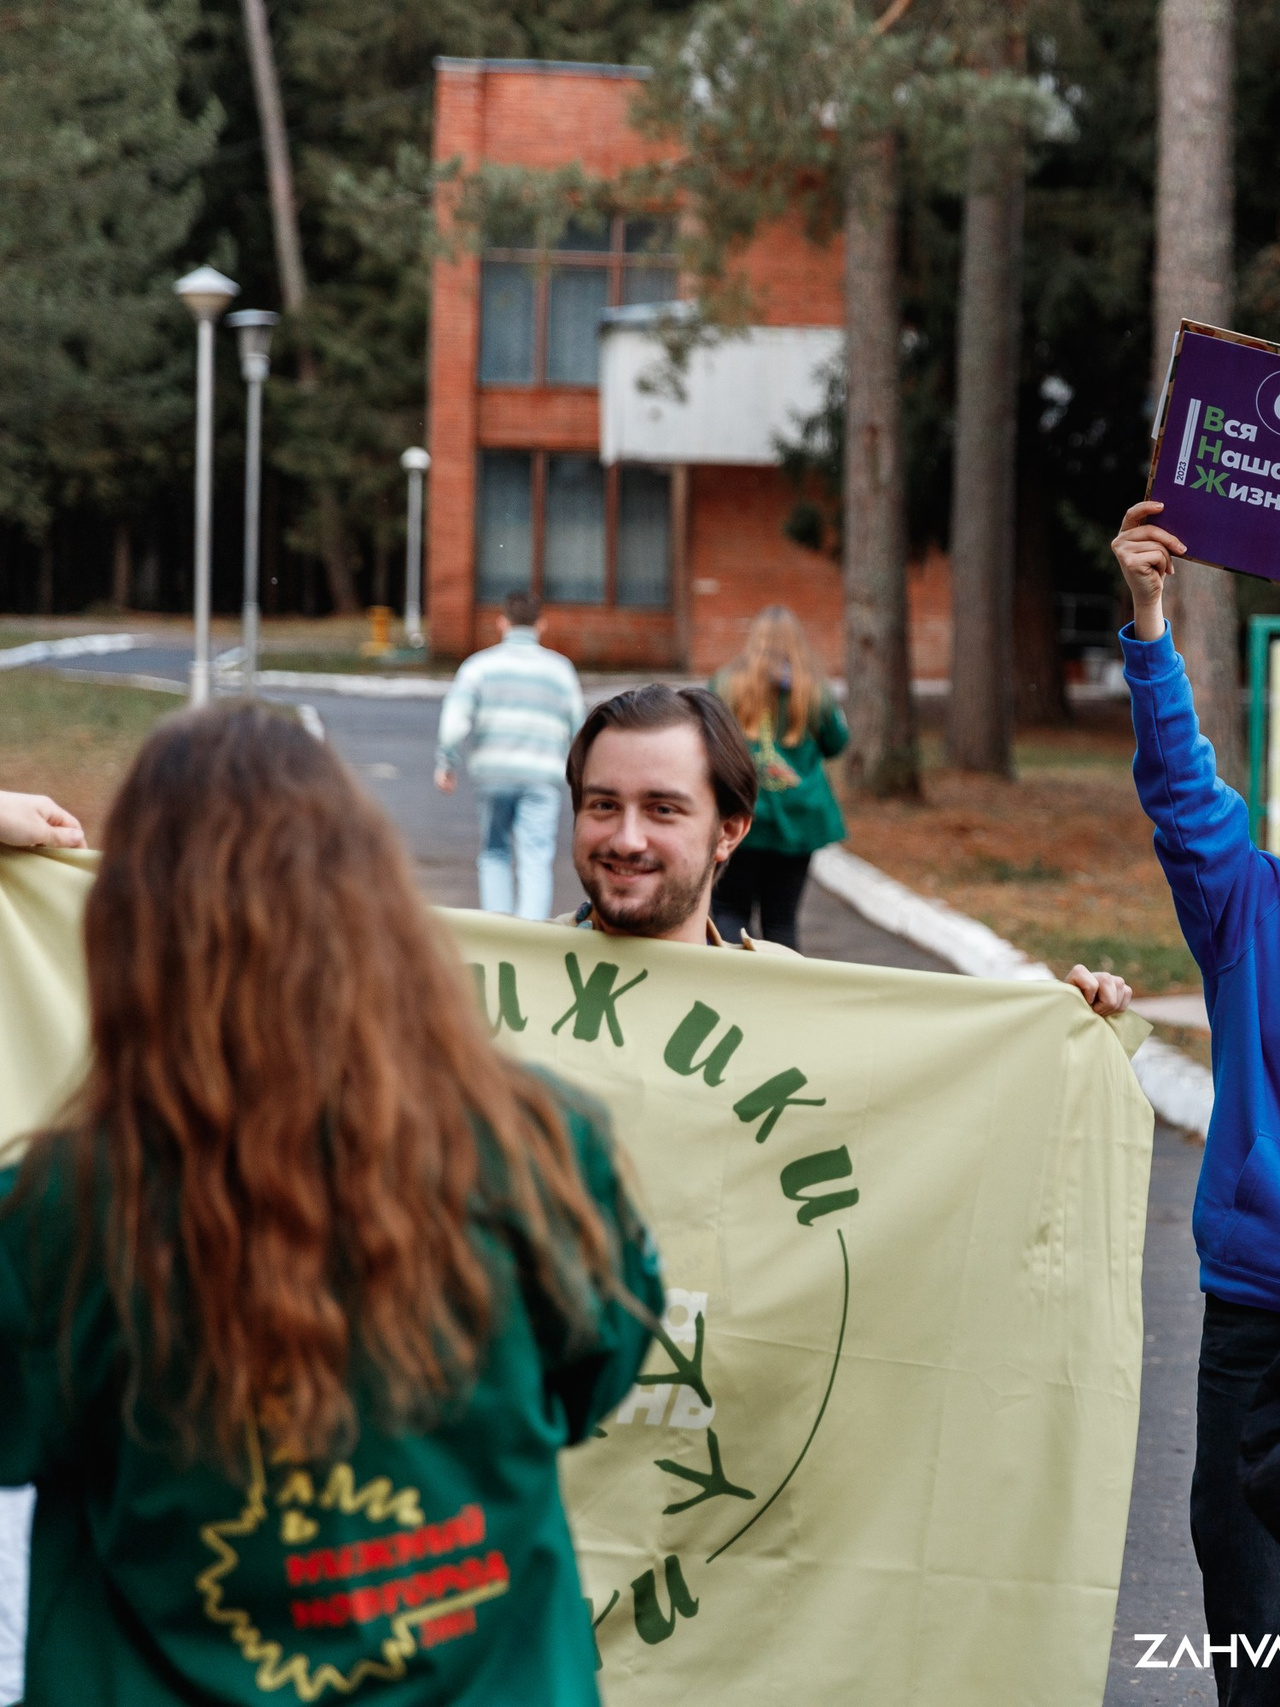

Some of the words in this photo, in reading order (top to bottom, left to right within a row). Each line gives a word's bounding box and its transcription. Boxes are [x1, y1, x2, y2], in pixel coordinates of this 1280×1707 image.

[1203, 405, 1258, 442] Вся
[1176, 461, 1187, 481] 2023
[464, 951, 860, 1227] ижики
